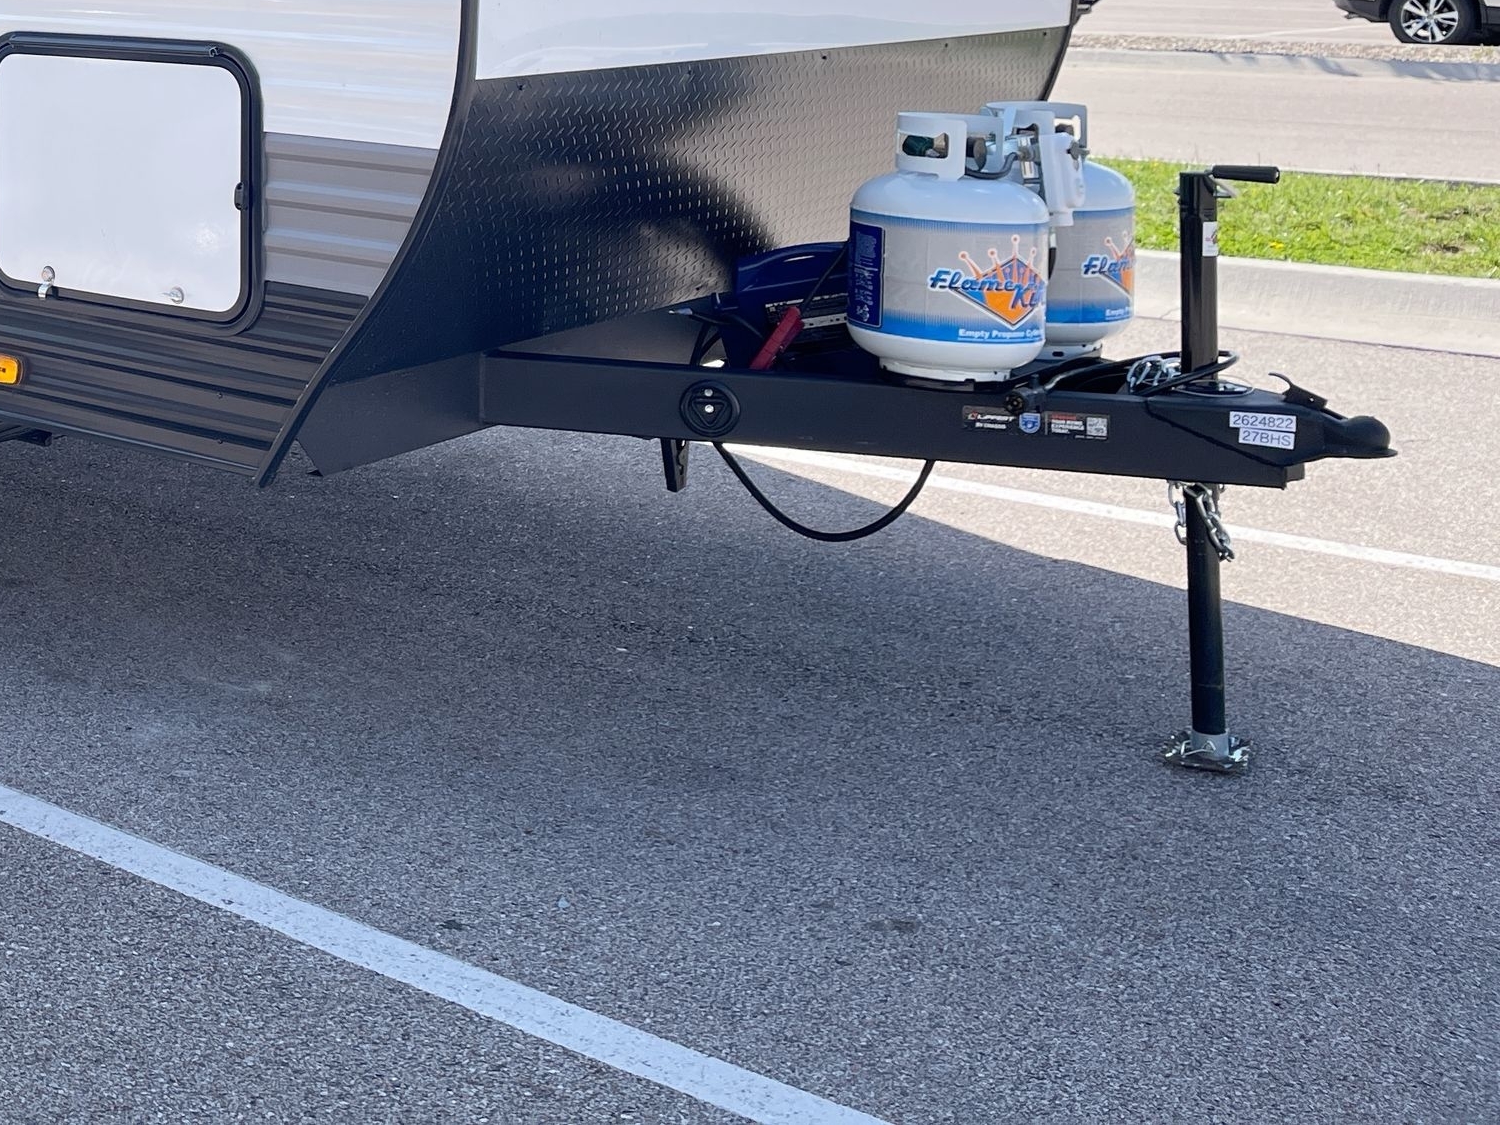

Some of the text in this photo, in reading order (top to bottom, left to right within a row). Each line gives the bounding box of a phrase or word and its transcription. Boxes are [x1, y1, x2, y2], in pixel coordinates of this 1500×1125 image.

[930, 270, 1016, 292] Flame
[959, 329, 989, 339] Empty
[1232, 414, 1294, 429] 2624822
[1242, 429, 1291, 447] 27BHS
